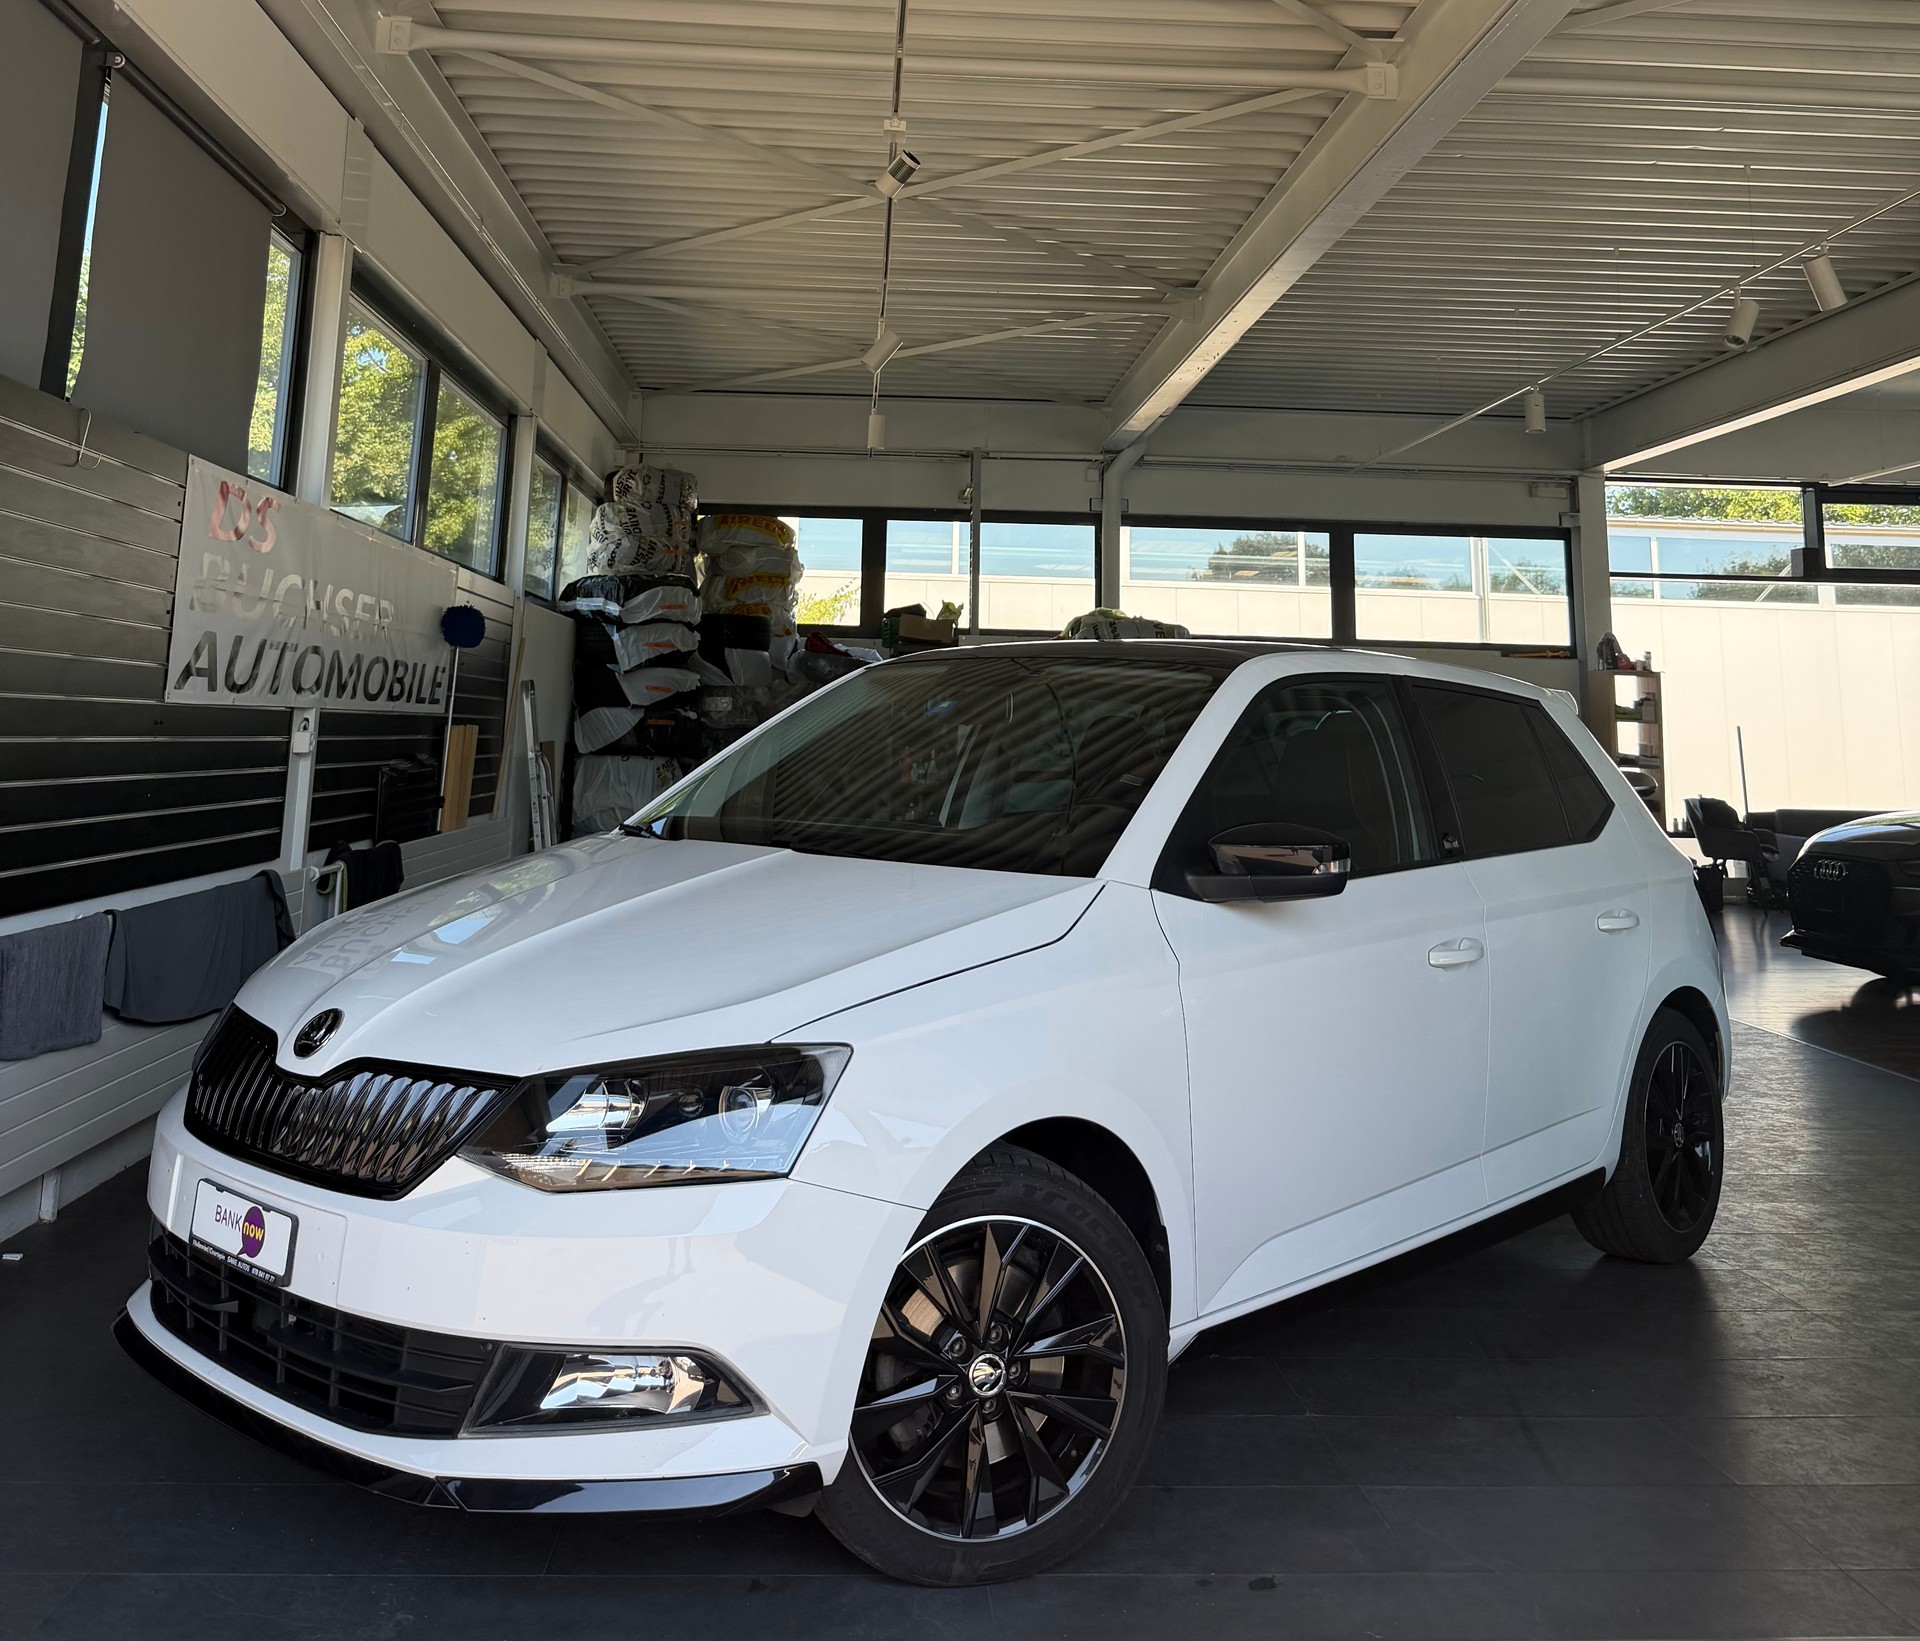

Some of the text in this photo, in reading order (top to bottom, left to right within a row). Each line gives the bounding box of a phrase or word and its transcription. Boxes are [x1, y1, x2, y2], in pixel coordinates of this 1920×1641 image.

[208, 480, 281, 553] DS
[174, 631, 446, 704] AUTOMOBILE
[215, 1204, 242, 1232] BANK
[243, 1222, 264, 1241] now
